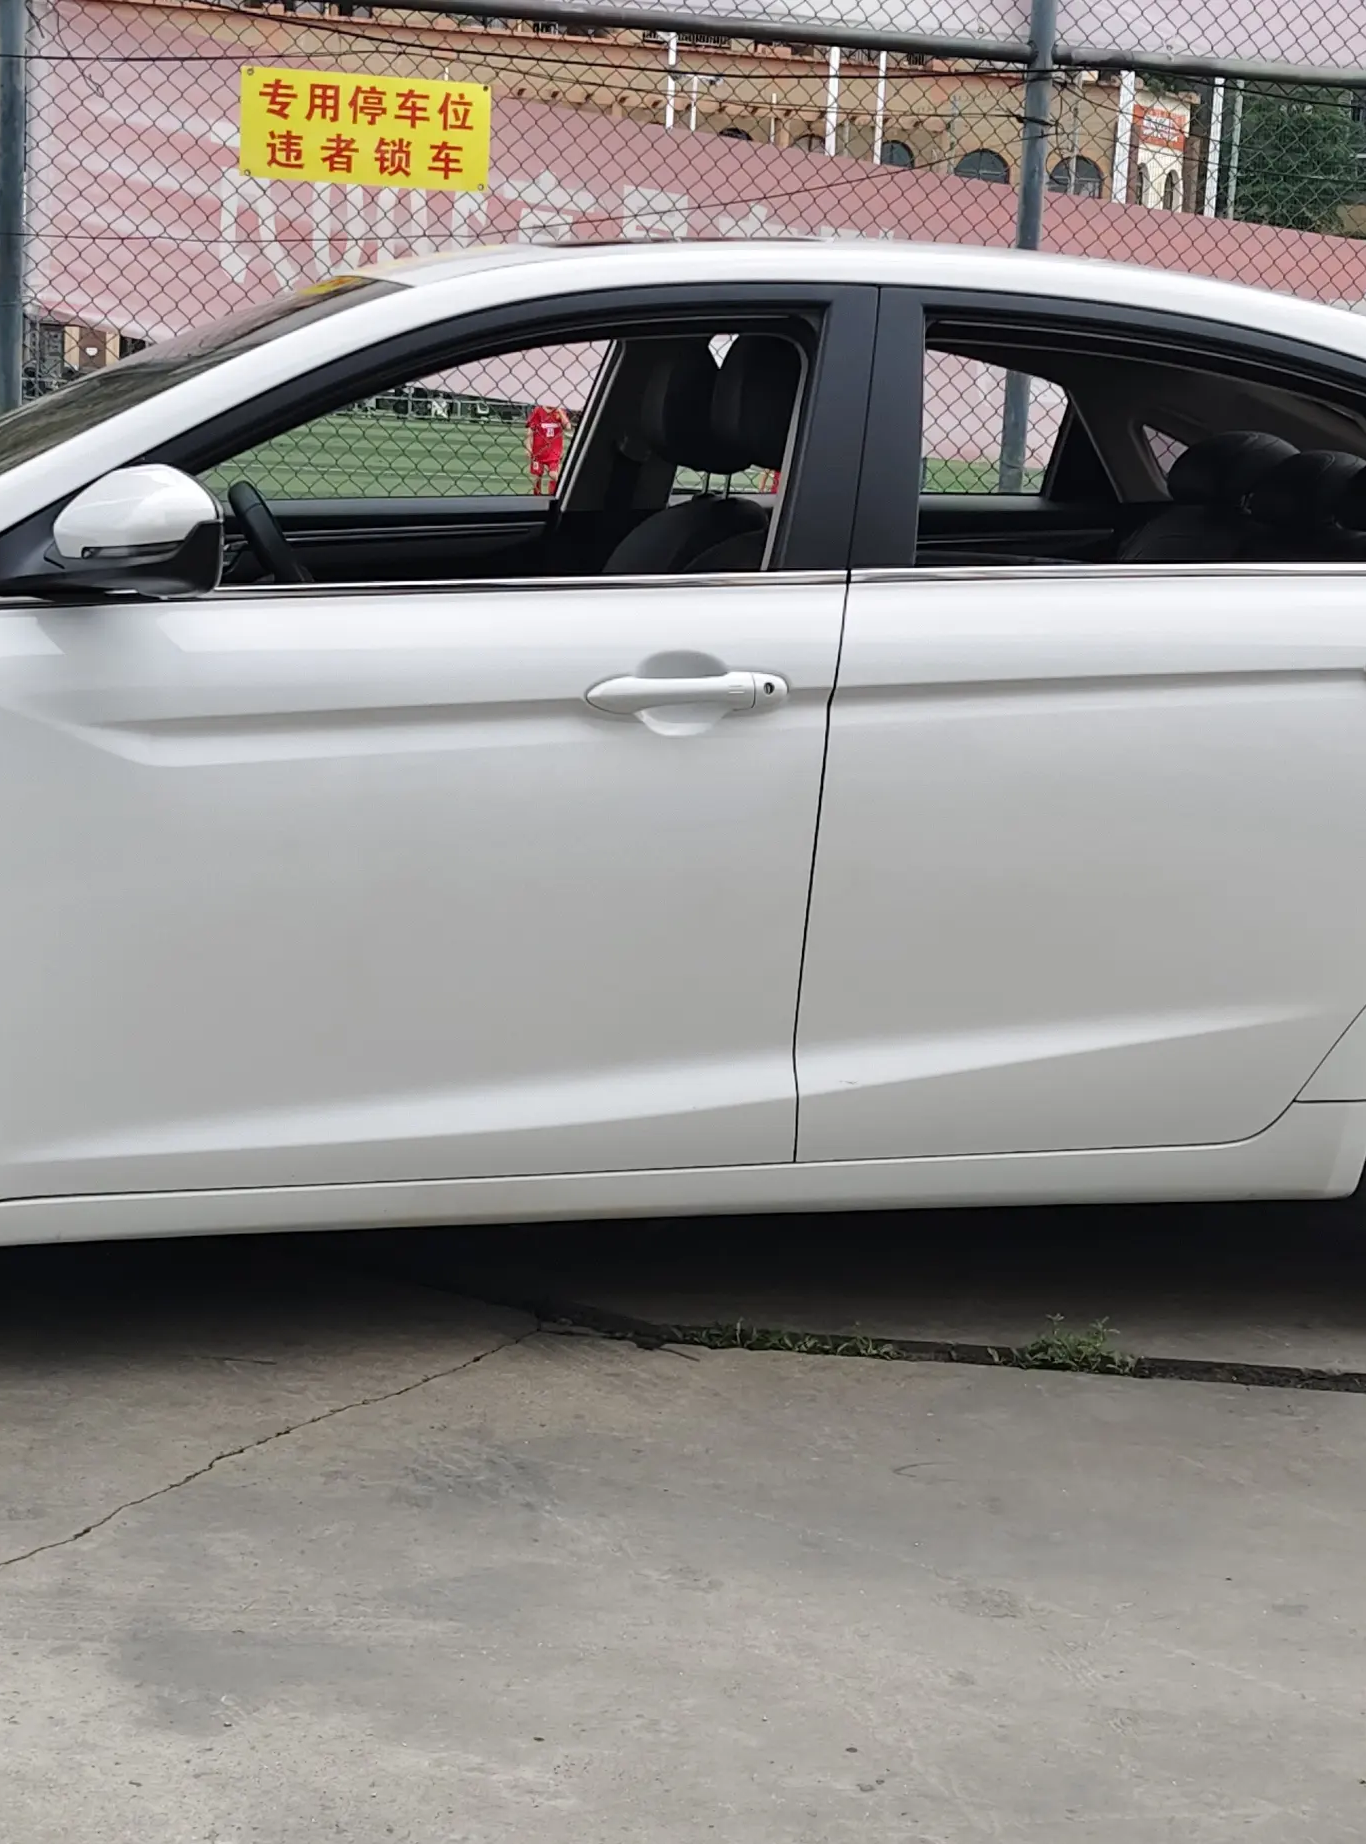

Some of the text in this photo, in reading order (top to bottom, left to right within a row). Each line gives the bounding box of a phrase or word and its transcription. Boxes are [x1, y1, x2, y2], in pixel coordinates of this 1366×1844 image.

[259, 78, 474, 131] 专用停车位
[266, 130, 464, 180] 违者锁车
